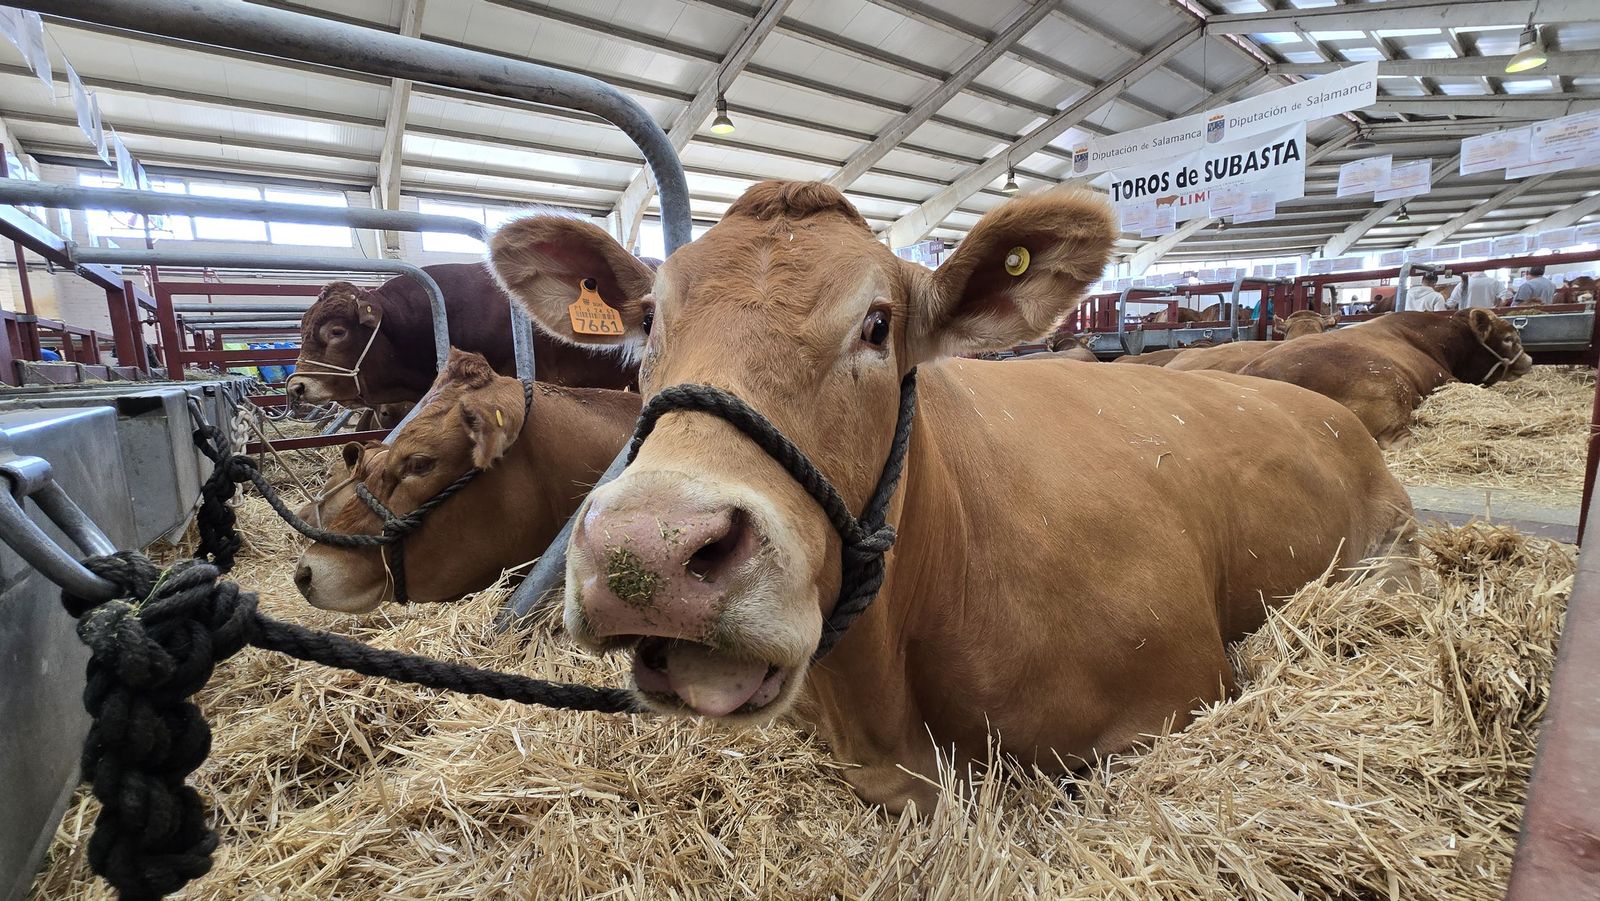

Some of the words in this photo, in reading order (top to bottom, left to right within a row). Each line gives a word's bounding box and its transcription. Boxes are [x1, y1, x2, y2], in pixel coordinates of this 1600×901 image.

[1229, 105, 1288, 129] Diputación
[1291, 102, 1302, 112] de
[1306, 81, 1372, 107] Salamanca
[1092, 144, 1138, 161] Diputación
[1140, 142, 1150, 151] de
[1152, 129, 1202, 148] Salamanca
[1112, 171, 1170, 202] TOROS
[1176, 166, 1198, 188] de
[1204, 138, 1301, 182] SUBASTA
[1180, 190, 1210, 206] LIM
[576, 318, 623, 333] 7661
